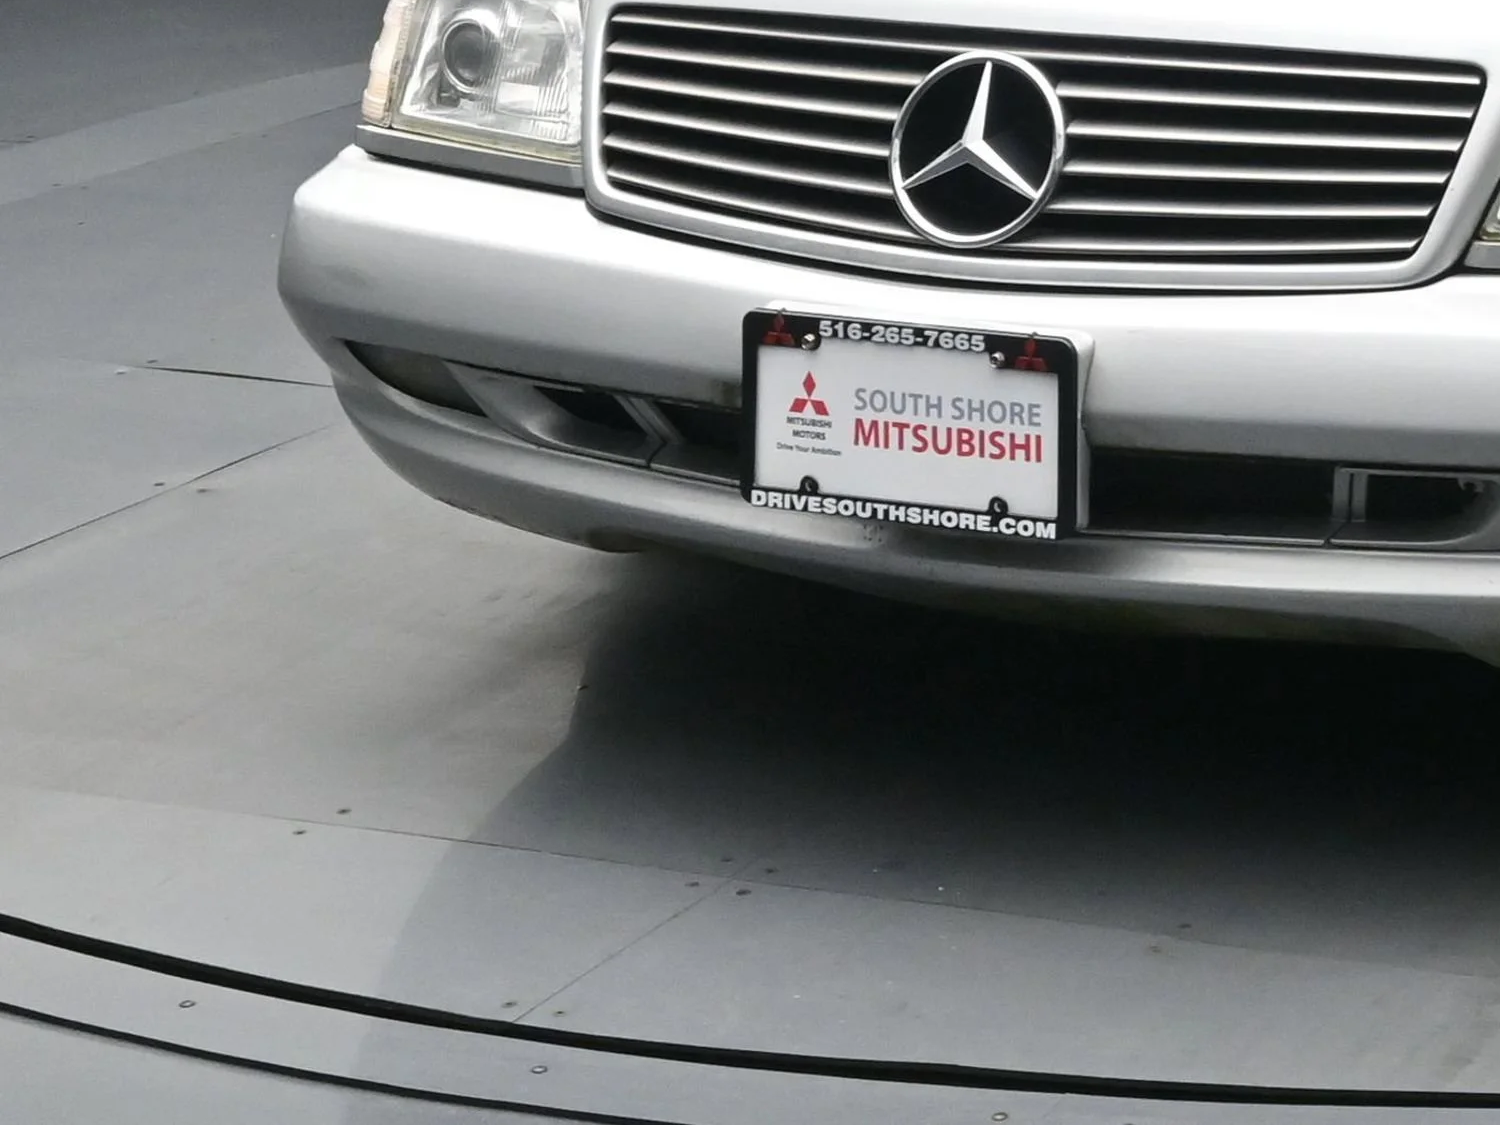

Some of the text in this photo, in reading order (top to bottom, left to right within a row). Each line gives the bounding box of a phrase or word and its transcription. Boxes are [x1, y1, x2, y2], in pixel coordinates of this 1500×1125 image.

[818, 320, 986, 352] 516-265-7665
[853, 387, 1042, 427] SOUTH SHORE
[792, 429, 826, 440] MOTORS
[853, 418, 1043, 463] MITSUBISHI
[751, 489, 1057, 540] DRIVESOUTHSHORE.COM
